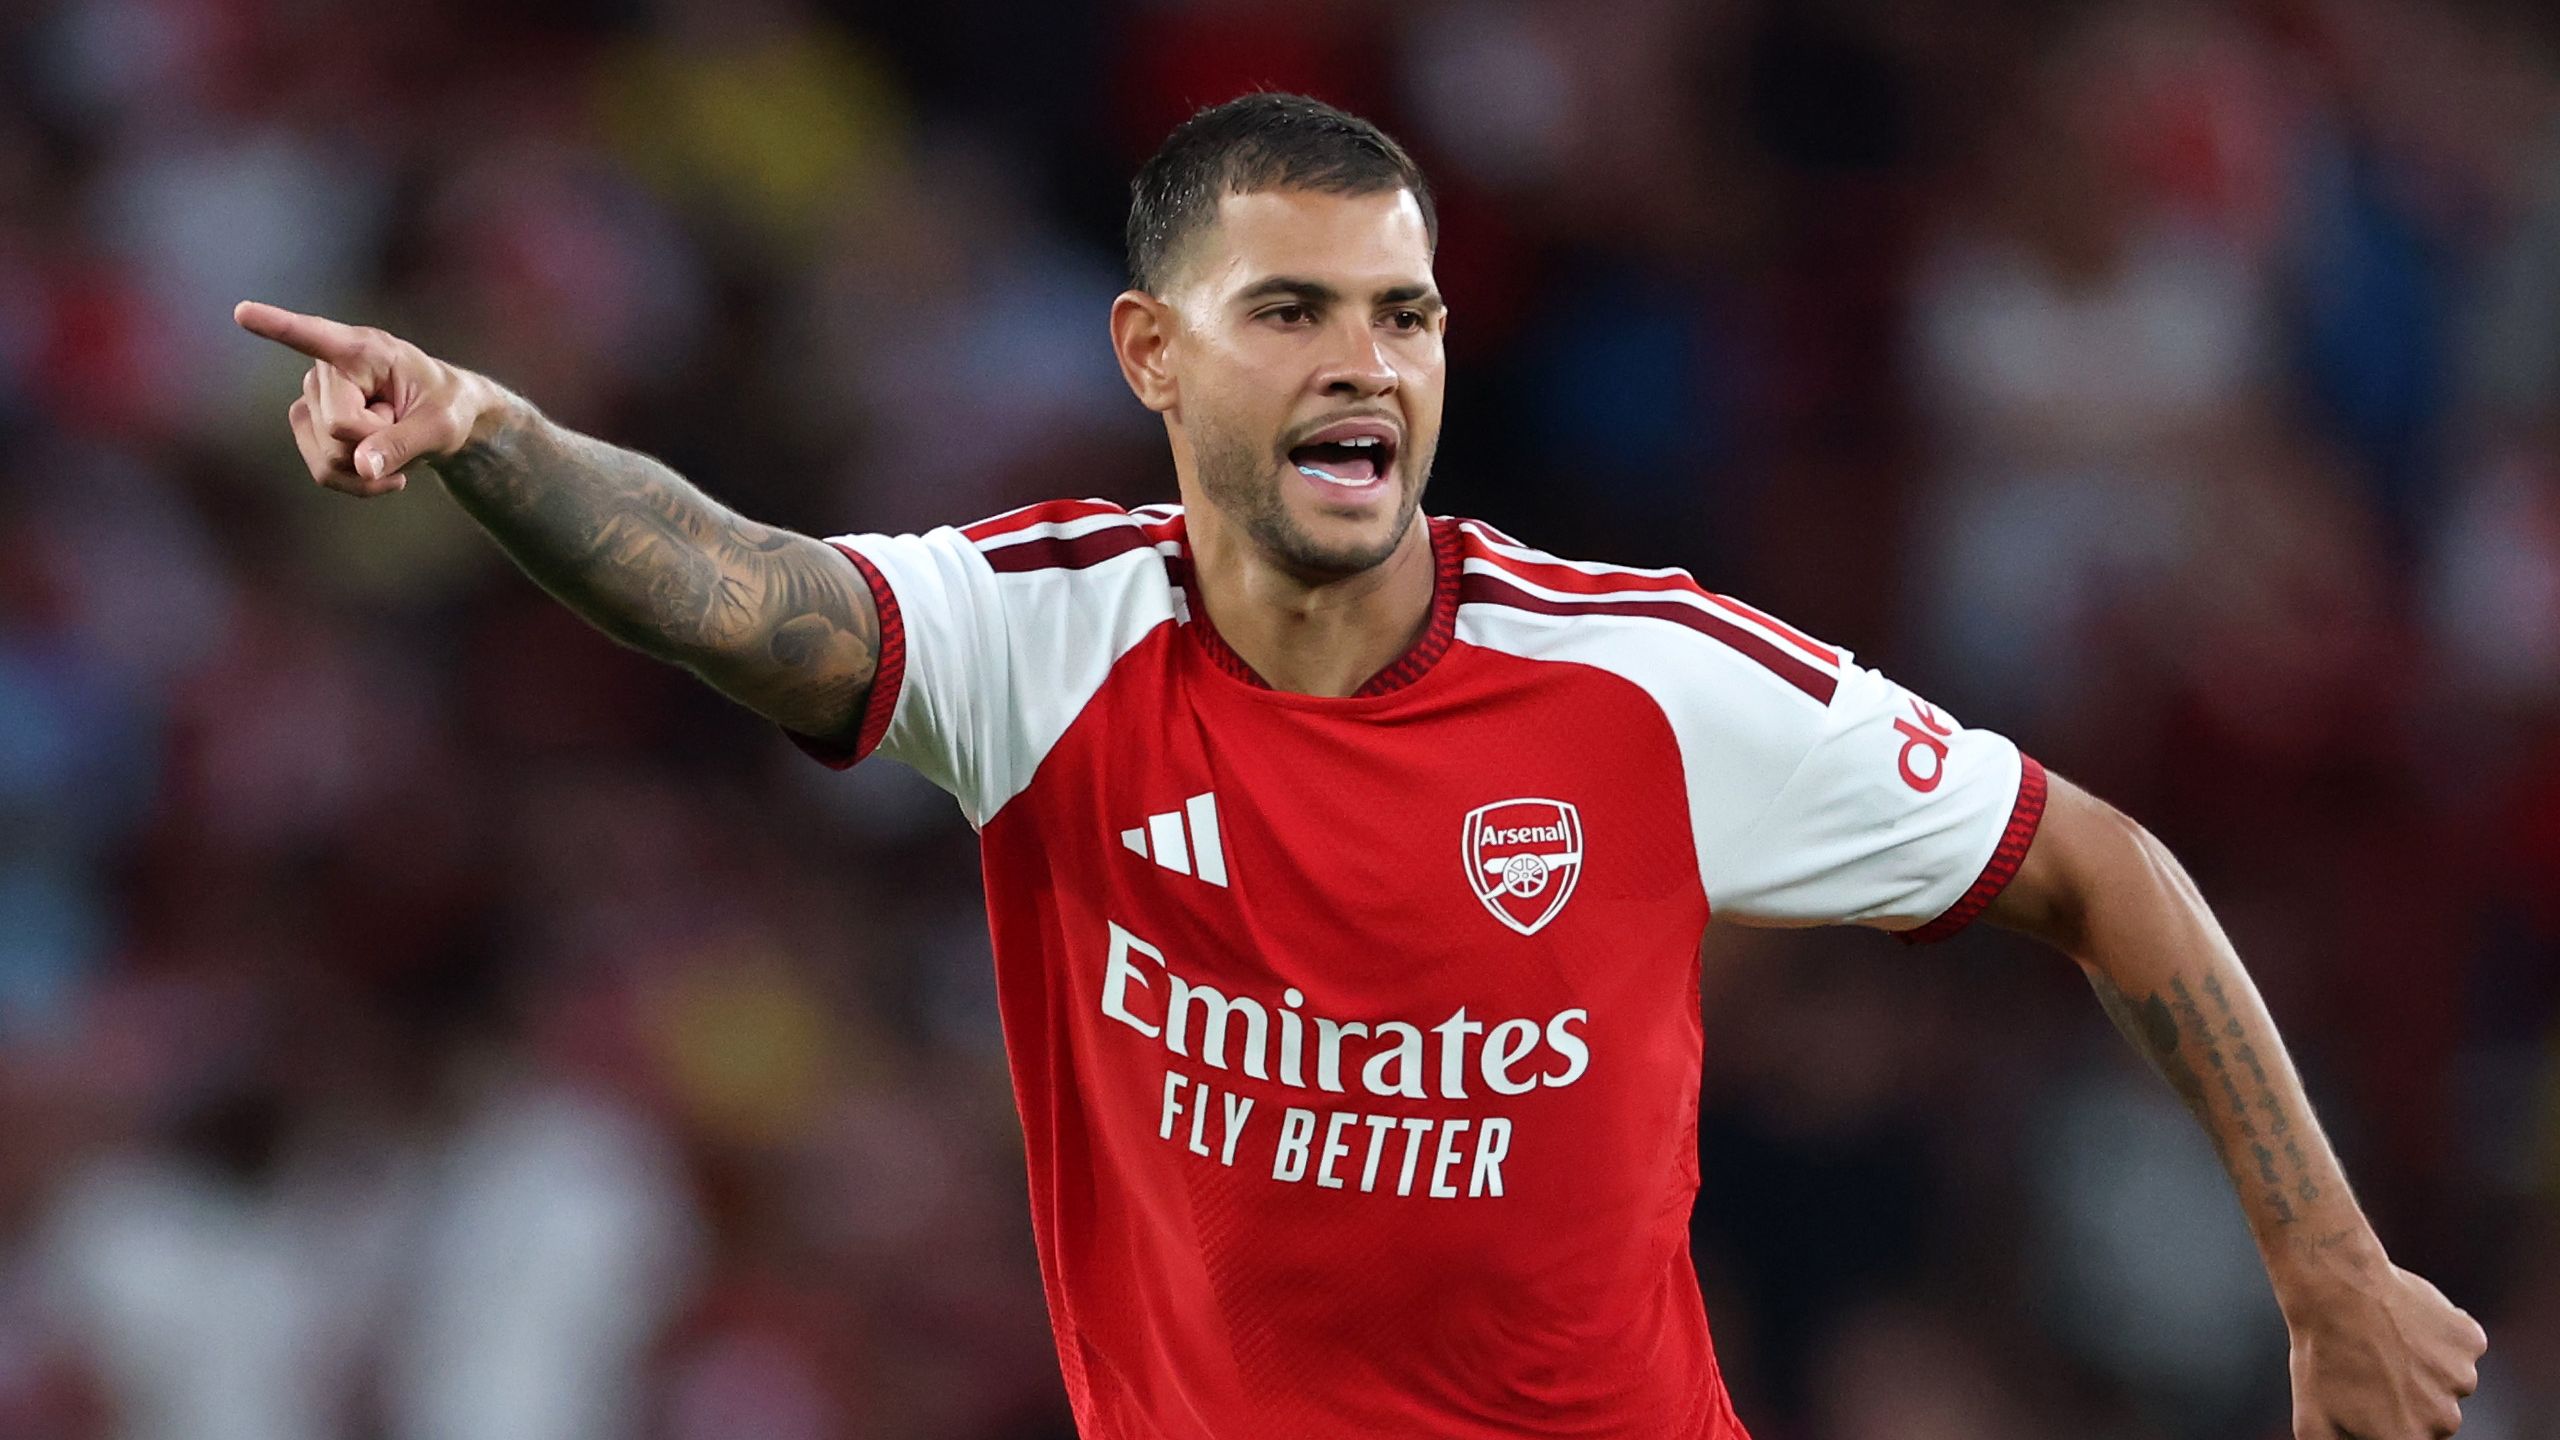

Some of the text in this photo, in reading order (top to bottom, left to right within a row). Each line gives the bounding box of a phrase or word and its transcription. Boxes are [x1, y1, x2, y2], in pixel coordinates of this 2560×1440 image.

[1480, 820, 1565, 846] Arsenal
[1101, 920, 1589, 1099] Emirates
[1159, 1070, 1512, 1198] FLY BETTER
